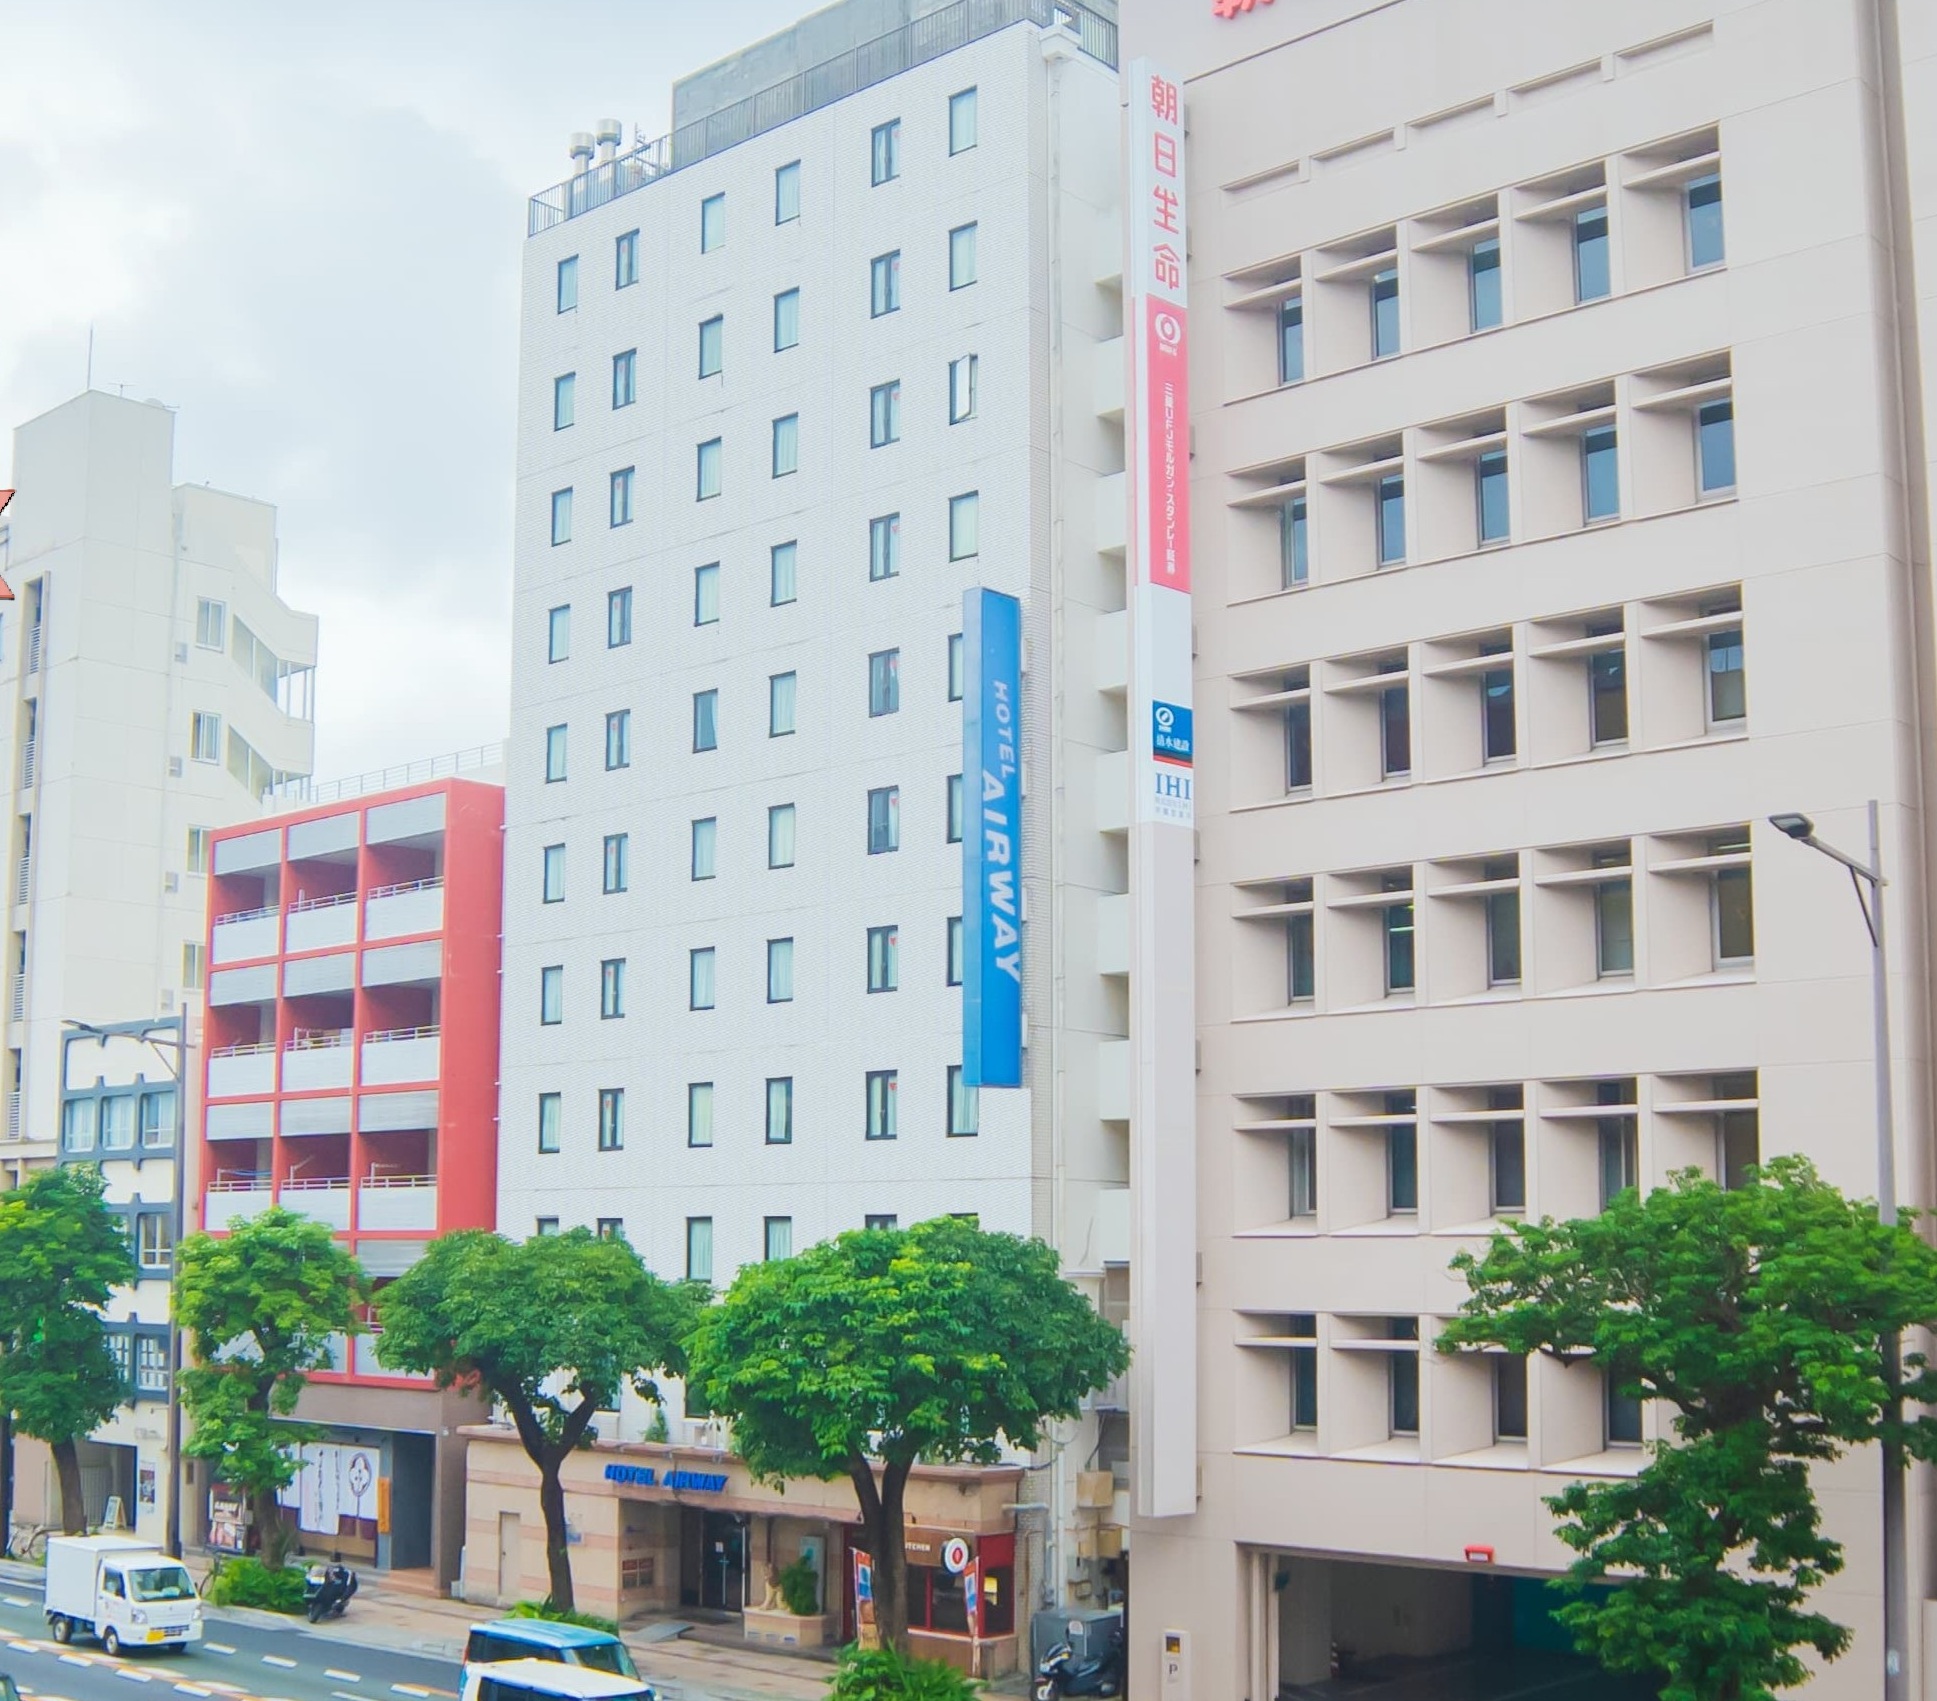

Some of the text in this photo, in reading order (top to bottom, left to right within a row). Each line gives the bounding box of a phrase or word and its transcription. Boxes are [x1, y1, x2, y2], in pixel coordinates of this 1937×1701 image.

[1151, 74, 1180, 290] 朝日生命
[1155, 772, 1191, 800] IHI
[982, 680, 1021, 984] HOTEL AIRWAY
[605, 1464, 730, 1492] HOTEL AIRWAY
[905, 1541, 931, 1551] ITCHEN
[1169, 1663, 1179, 1675] P
